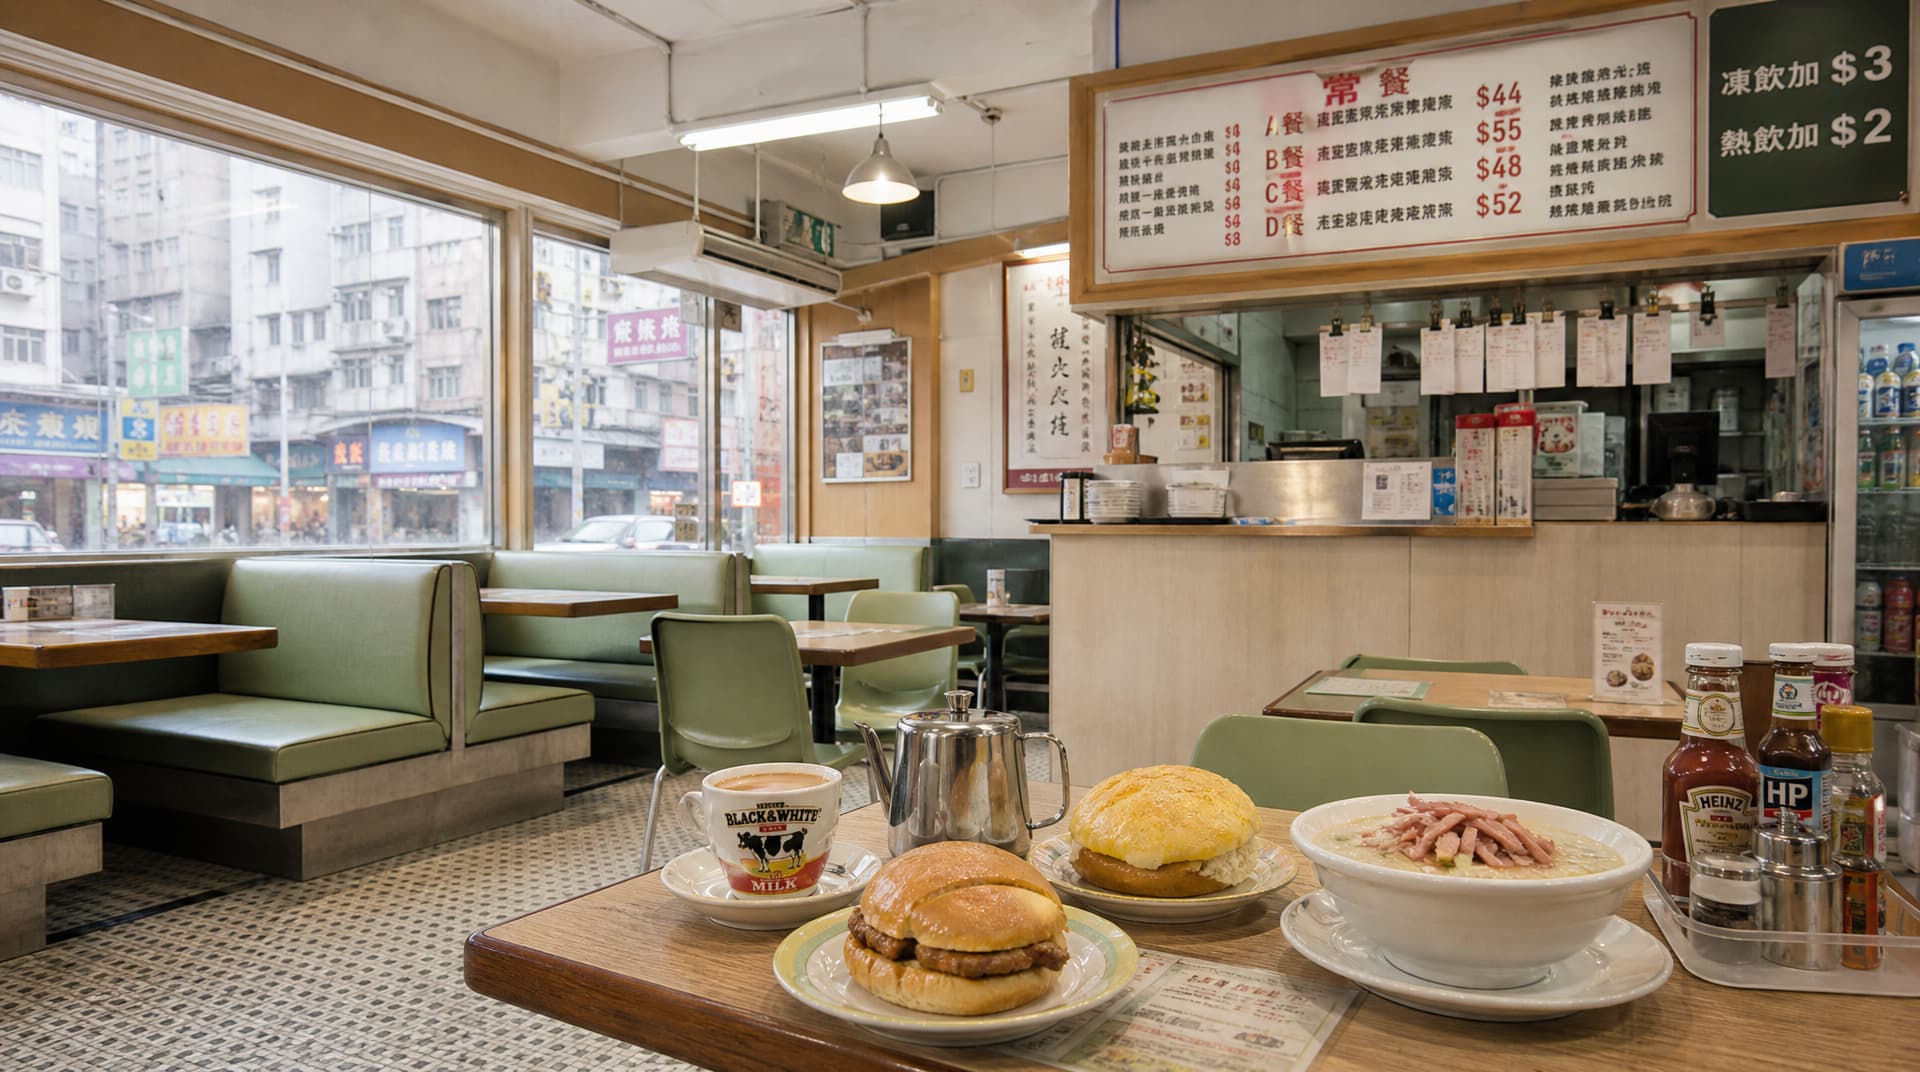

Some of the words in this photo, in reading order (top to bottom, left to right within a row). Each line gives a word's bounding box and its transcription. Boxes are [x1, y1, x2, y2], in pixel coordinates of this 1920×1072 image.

[1721, 61, 1819, 96] 凍飲加
[1831, 45, 1893, 86] $3
[1323, 66, 1409, 107] 常餐
[1477, 81, 1522, 110] $44
[1477, 117, 1522, 146] $55
[1721, 121, 1819, 158] 熱飲加
[1831, 108, 1892, 149] $2
[1265, 145, 1304, 171] B餐
[1477, 154, 1522, 182] $48
[1265, 178, 1304, 204] C餐
[1477, 191, 1522, 219] $52
[1700, 796, 1744, 812] HEINZ
[1767, 780, 1809, 807] HP
[725, 809, 819, 826] BLACK&WHITE
[751, 879, 797, 891] MILK
